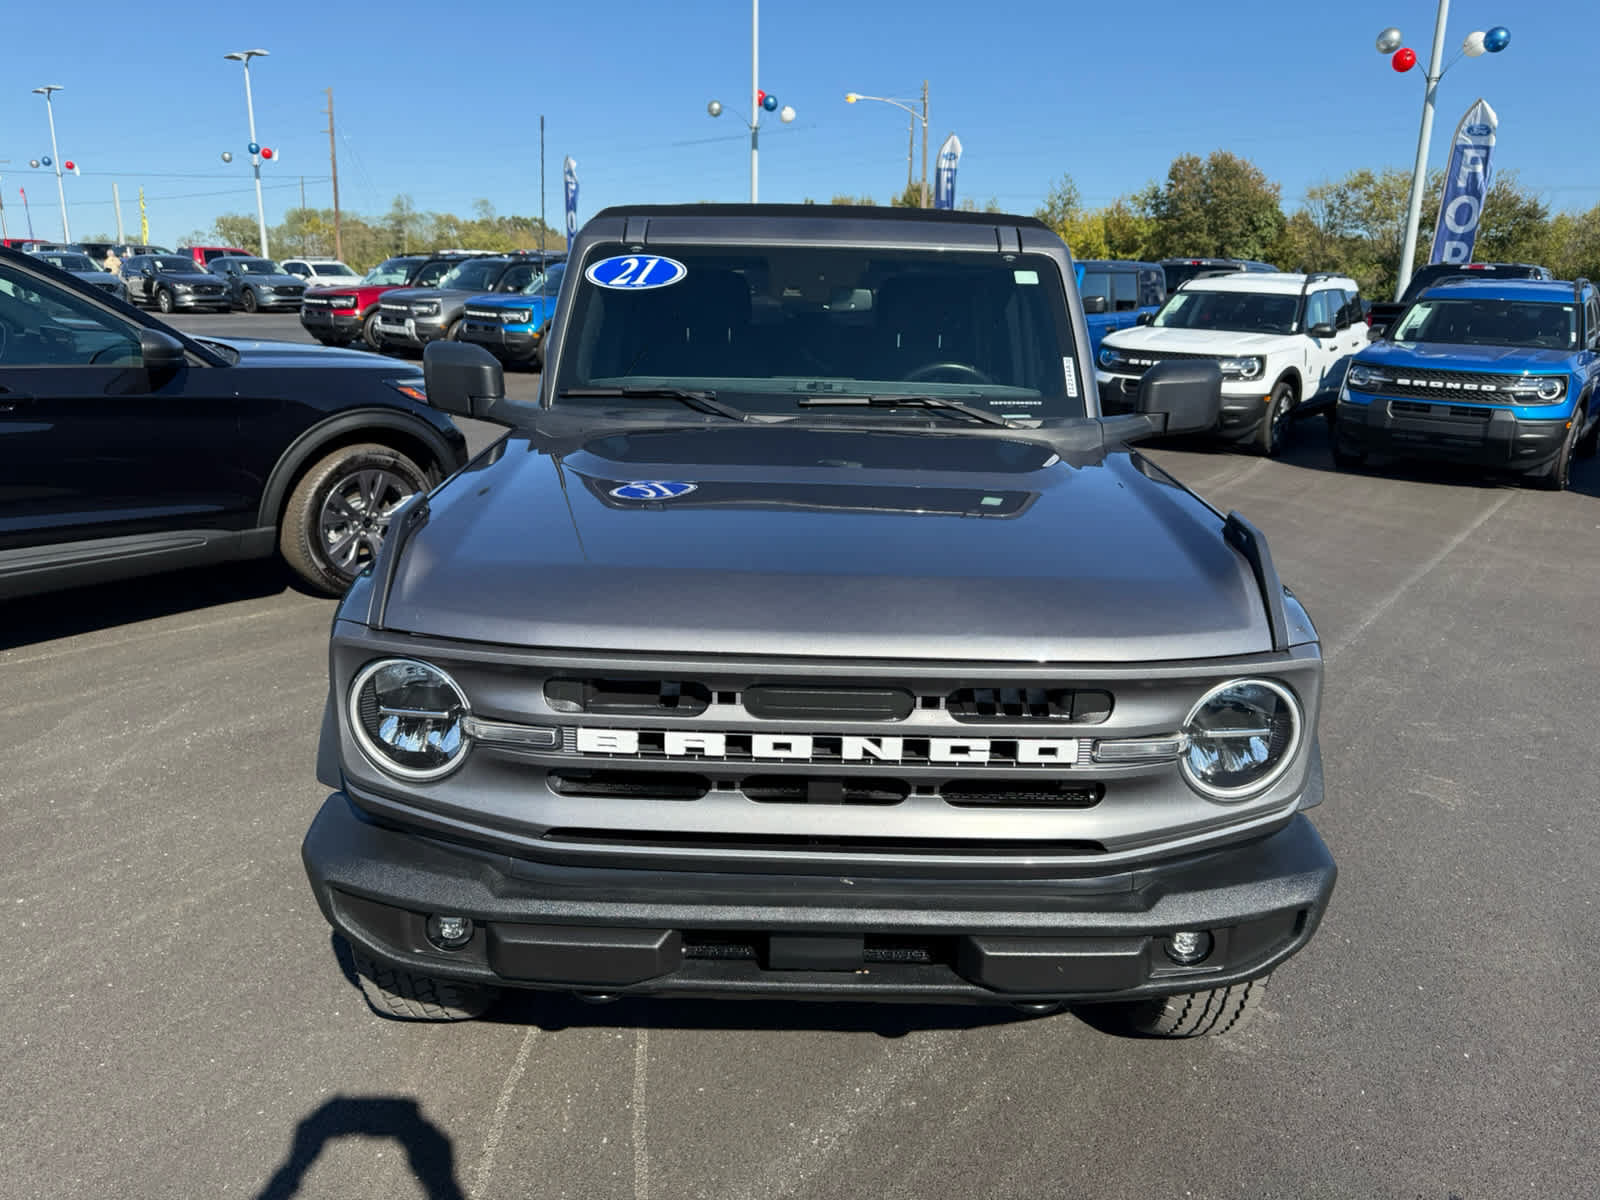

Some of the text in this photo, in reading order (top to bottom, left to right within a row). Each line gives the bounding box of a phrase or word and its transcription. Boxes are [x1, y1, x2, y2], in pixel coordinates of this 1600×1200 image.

[608, 258, 660, 285] 21
[1396, 378, 1497, 392] BRONCO
[576, 727, 1079, 763] BRONCO
